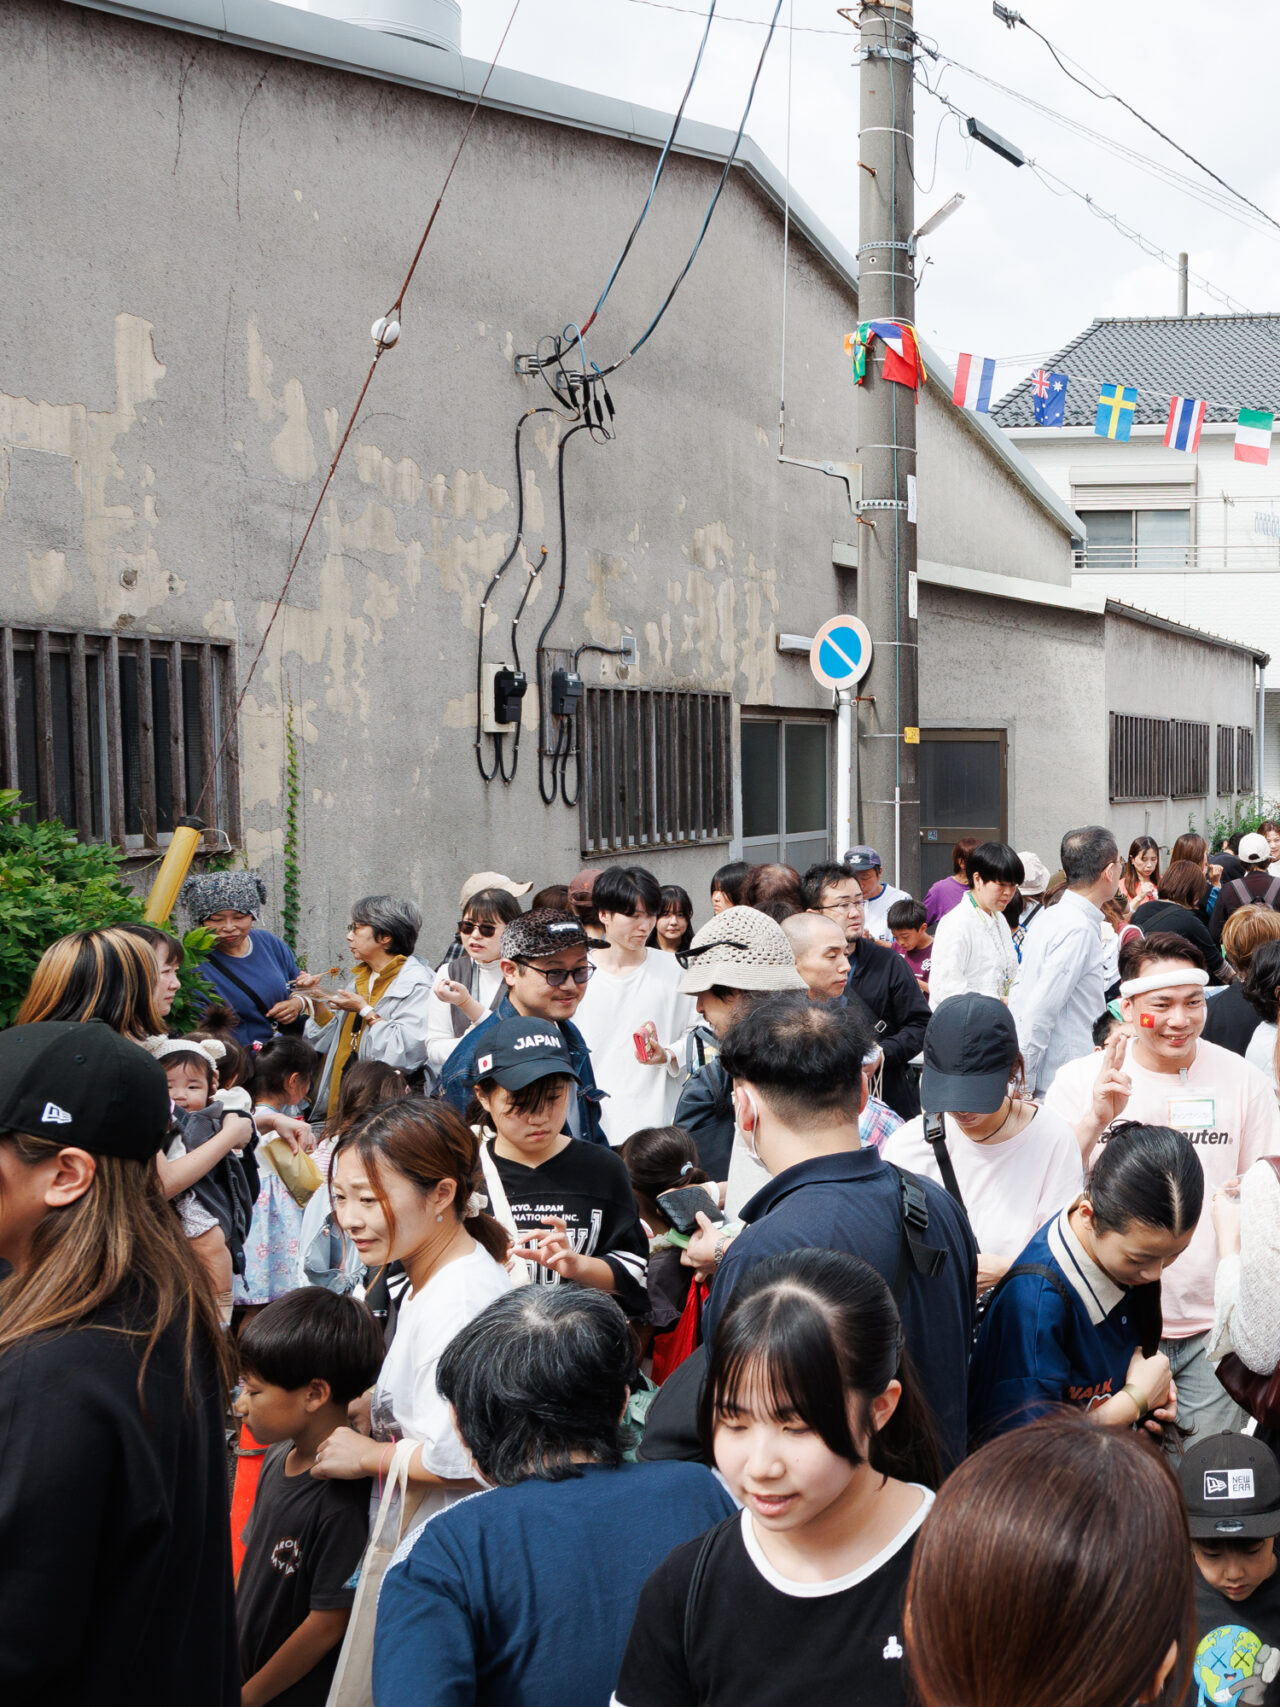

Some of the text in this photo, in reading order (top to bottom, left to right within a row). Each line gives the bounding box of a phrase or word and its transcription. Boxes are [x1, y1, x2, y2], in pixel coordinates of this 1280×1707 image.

[513, 1034, 562, 1051] JAPAN
[512, 1204, 564, 1212] KYO. JAPAN
[1232, 1475, 1251, 1484] NEW
[1232, 1484, 1251, 1492] ERA
